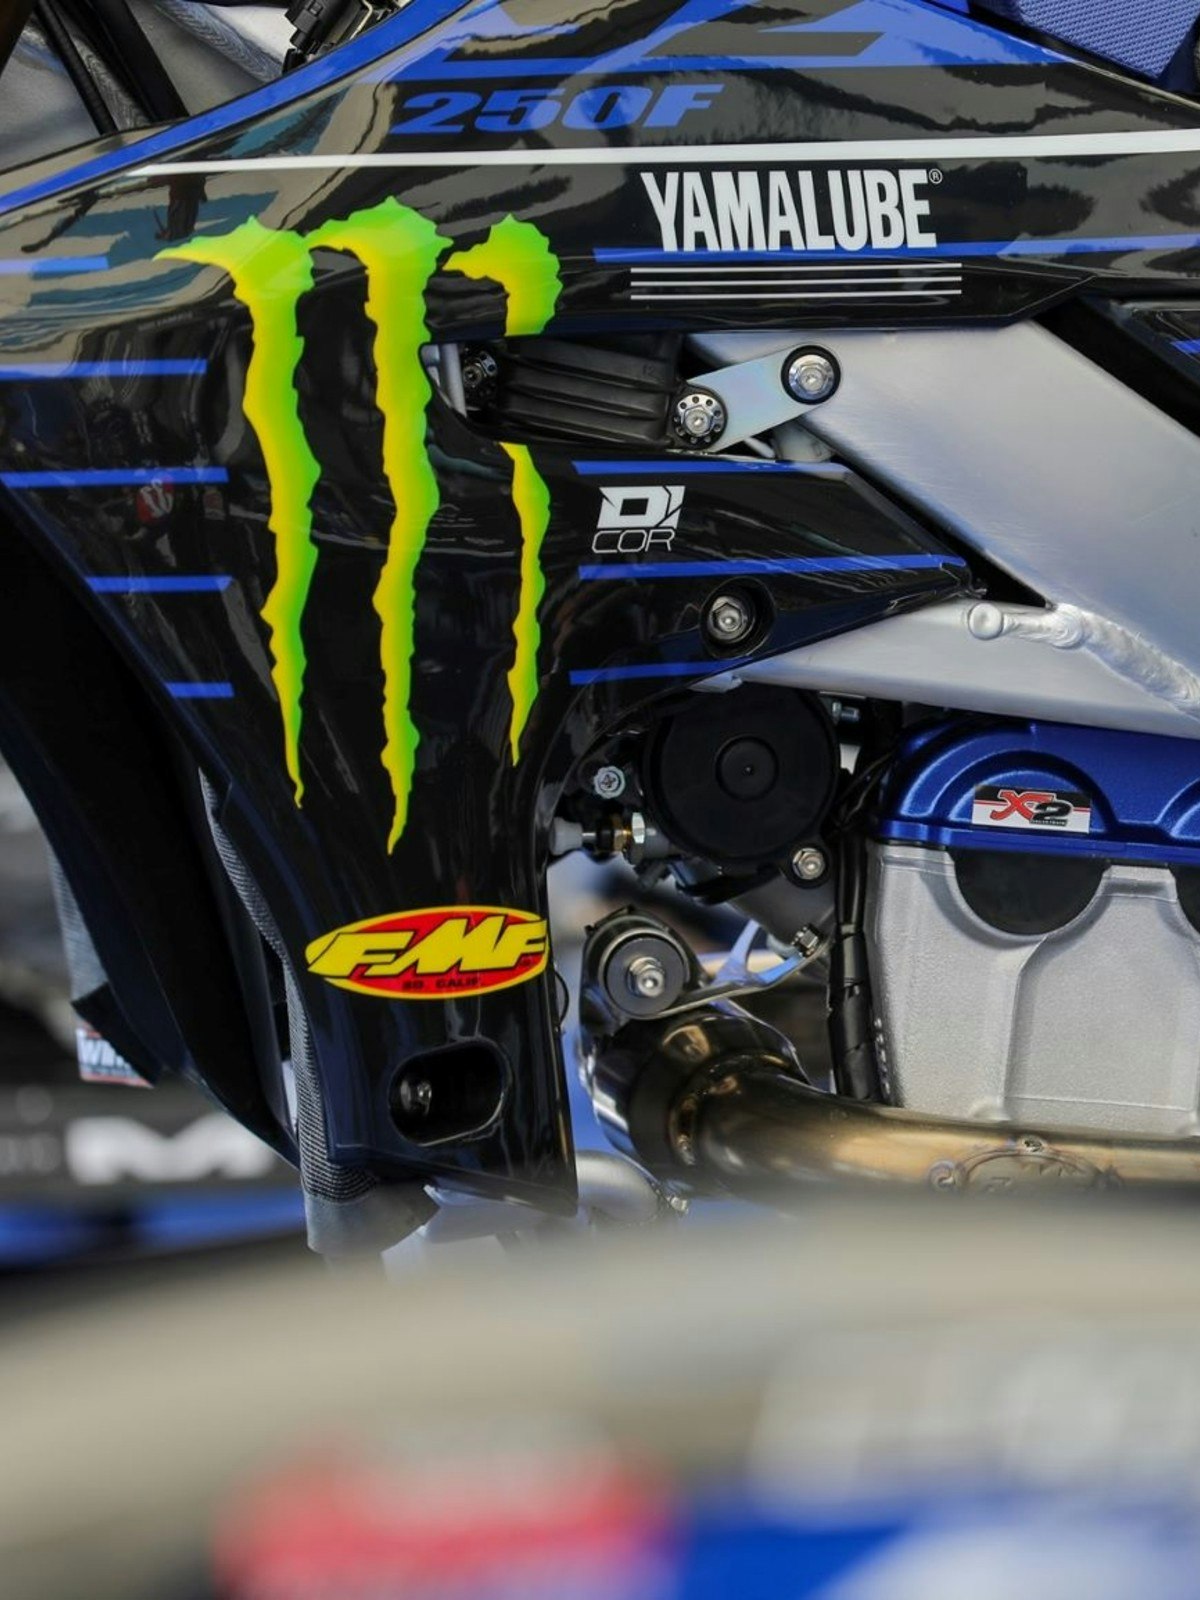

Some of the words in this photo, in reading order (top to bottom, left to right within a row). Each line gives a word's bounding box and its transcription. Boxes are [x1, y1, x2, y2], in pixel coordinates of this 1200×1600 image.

[389, 84, 725, 134] 250F
[592, 529, 675, 553] COR
[989, 789, 1073, 822] X2
[307, 914, 548, 978] FMF
